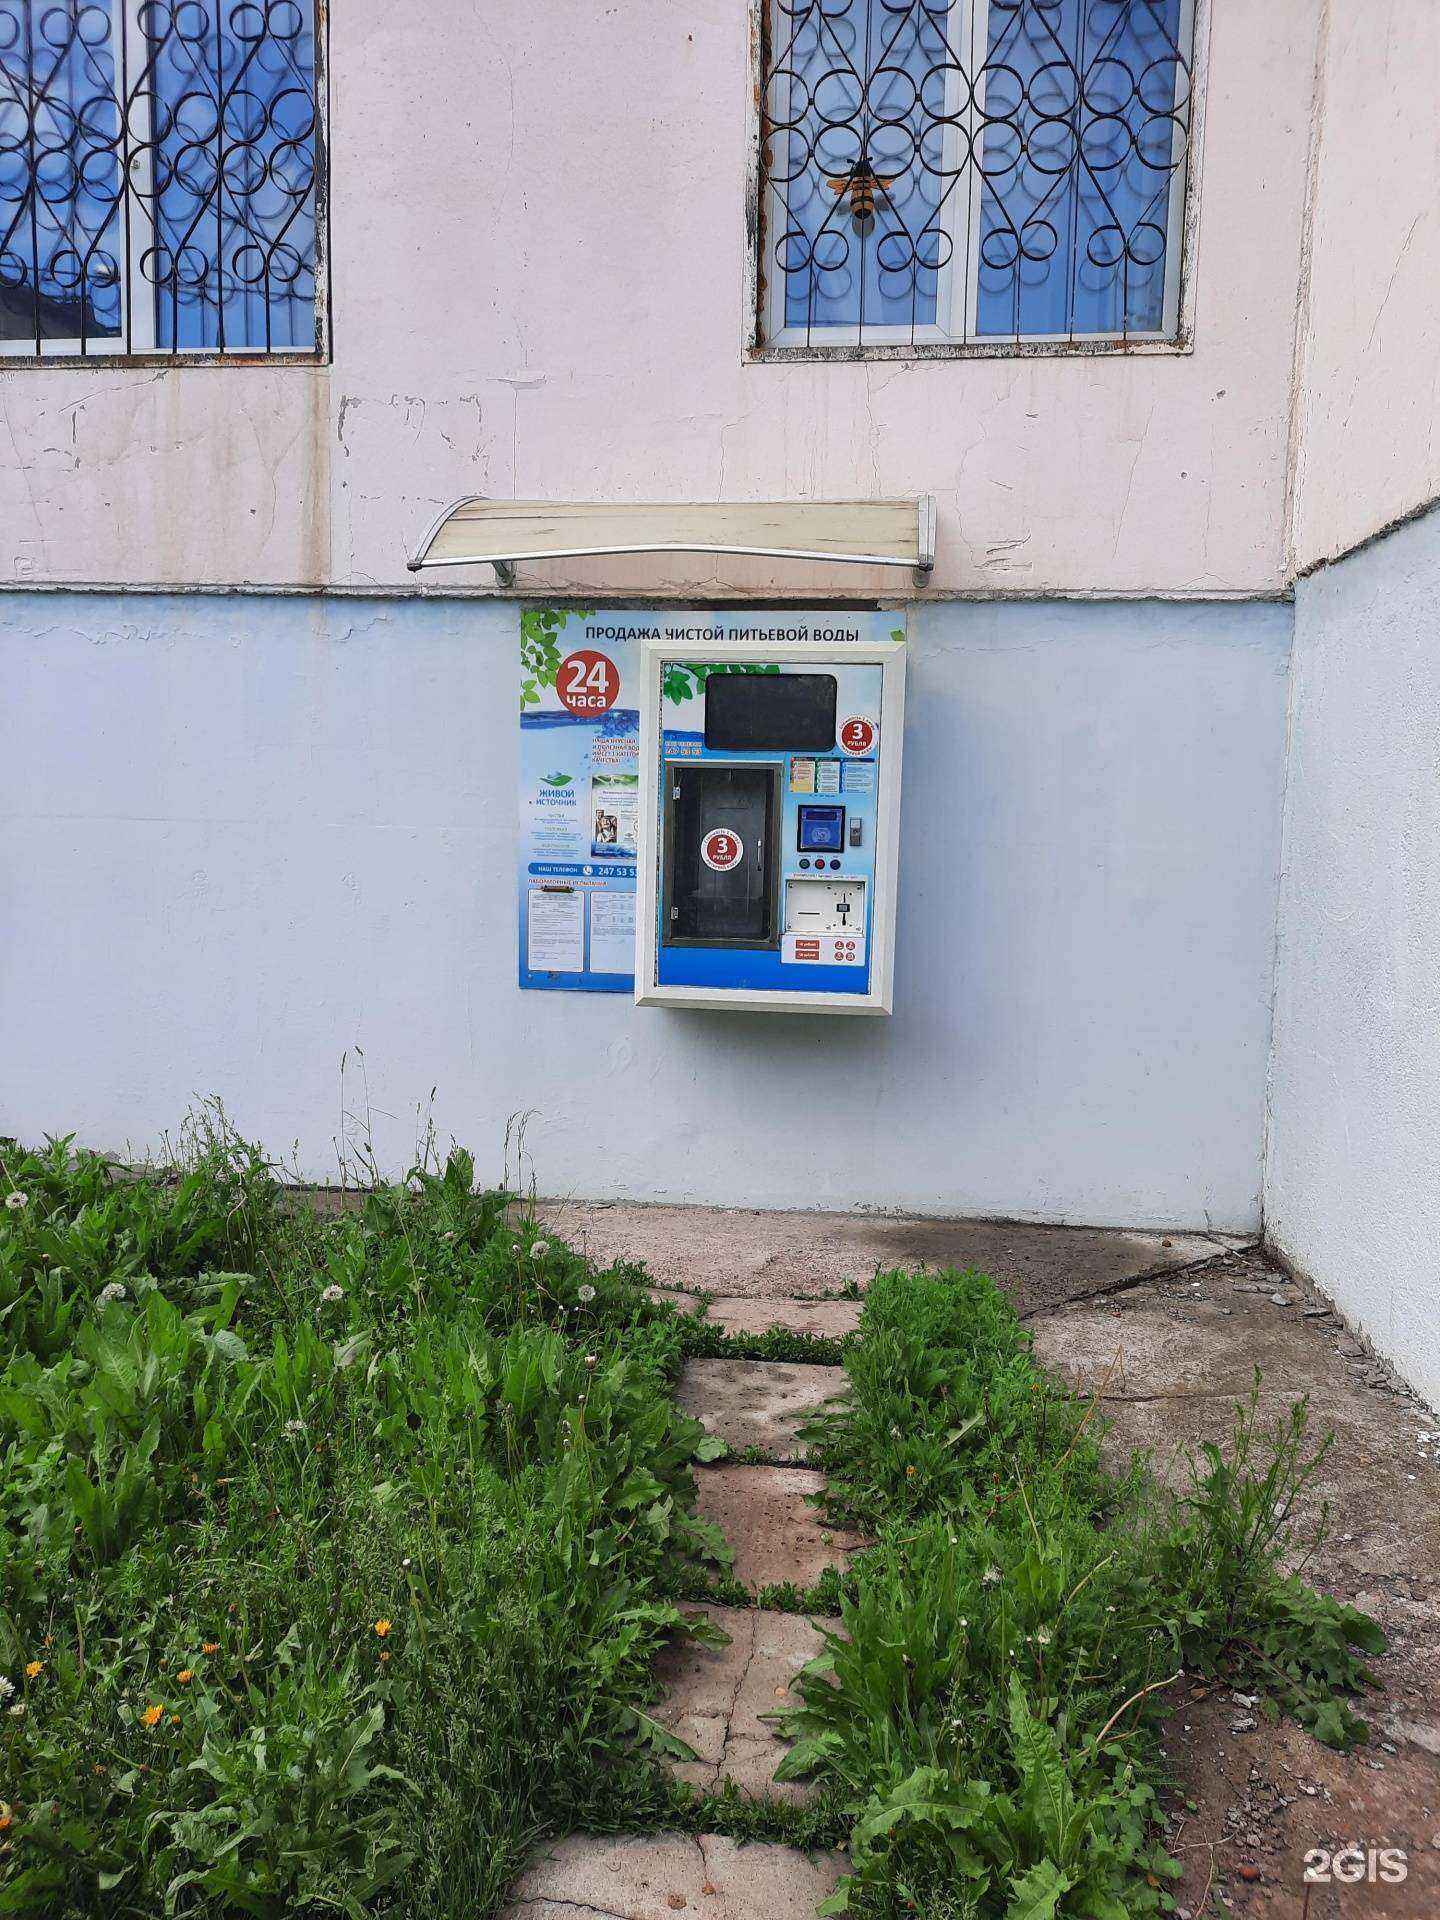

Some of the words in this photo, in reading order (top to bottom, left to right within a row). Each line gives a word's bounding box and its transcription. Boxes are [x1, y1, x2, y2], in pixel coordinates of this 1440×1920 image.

[586, 627, 660, 641] ПРОДАЖА
[665, 625, 724, 640] ЧИСТОЙ
[729, 626, 808, 641] ПИТЬЕВОЙ
[813, 629, 859, 641] ВОДЫ
[566, 660, 609, 693] 24
[566, 695, 606, 708] часа
[852, 723, 863, 740] 3
[539, 788, 575, 798] ЖИВОЙ
[717, 837, 728, 854] 3
[598, 867, 614, 876] 247
[616, 868, 629, 876] 53
